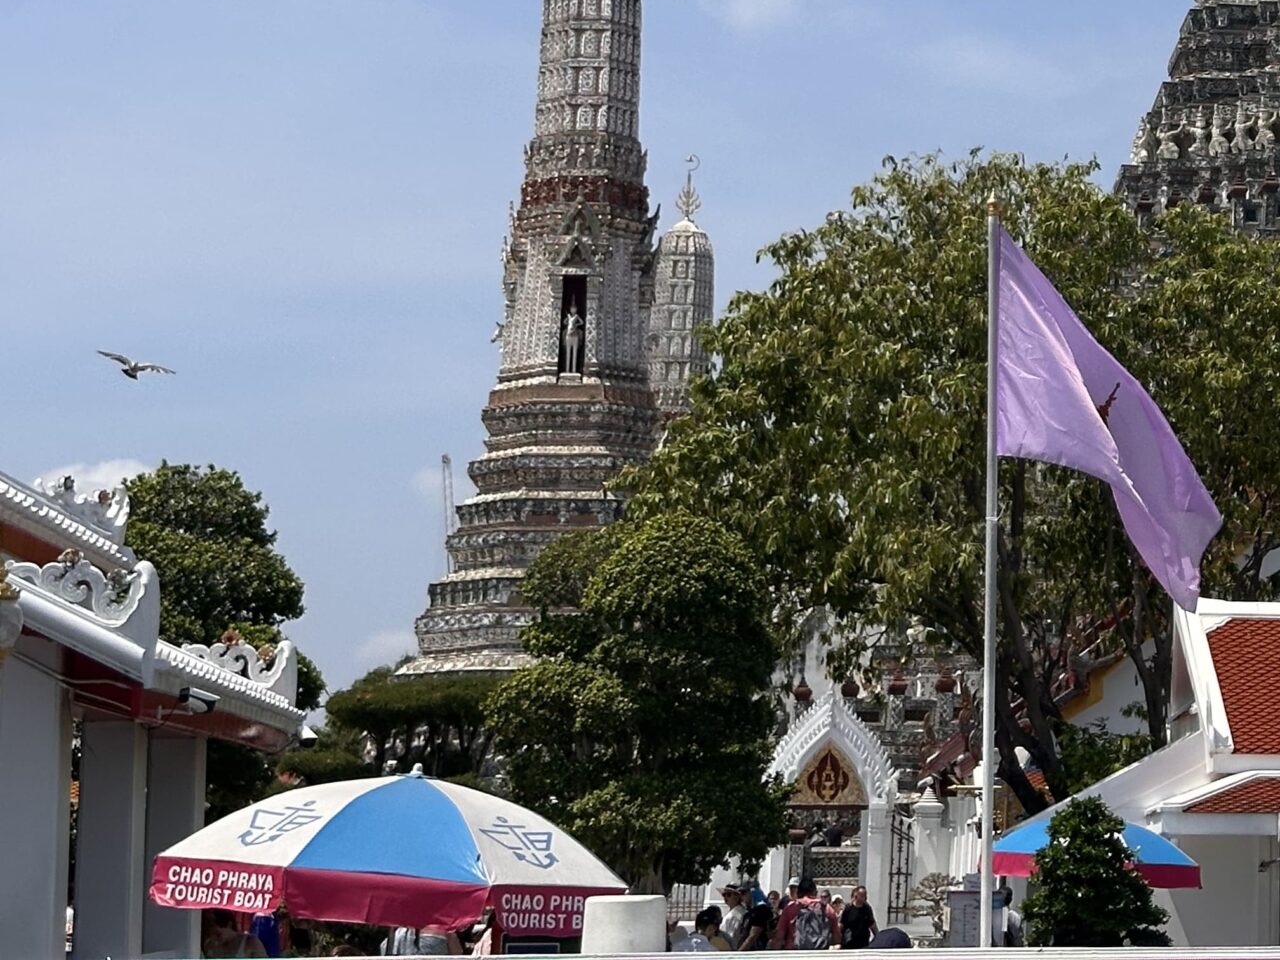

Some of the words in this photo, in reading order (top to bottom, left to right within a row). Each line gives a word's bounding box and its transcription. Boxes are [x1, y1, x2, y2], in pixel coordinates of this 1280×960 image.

[168, 865, 214, 885] CHAO
[217, 871, 274, 891] PHRAYA
[165, 884, 231, 906] TOURIST
[233, 891, 273, 909] BOAT
[502, 893, 545, 911] CHAO
[502, 912, 566, 929] TOURIST
